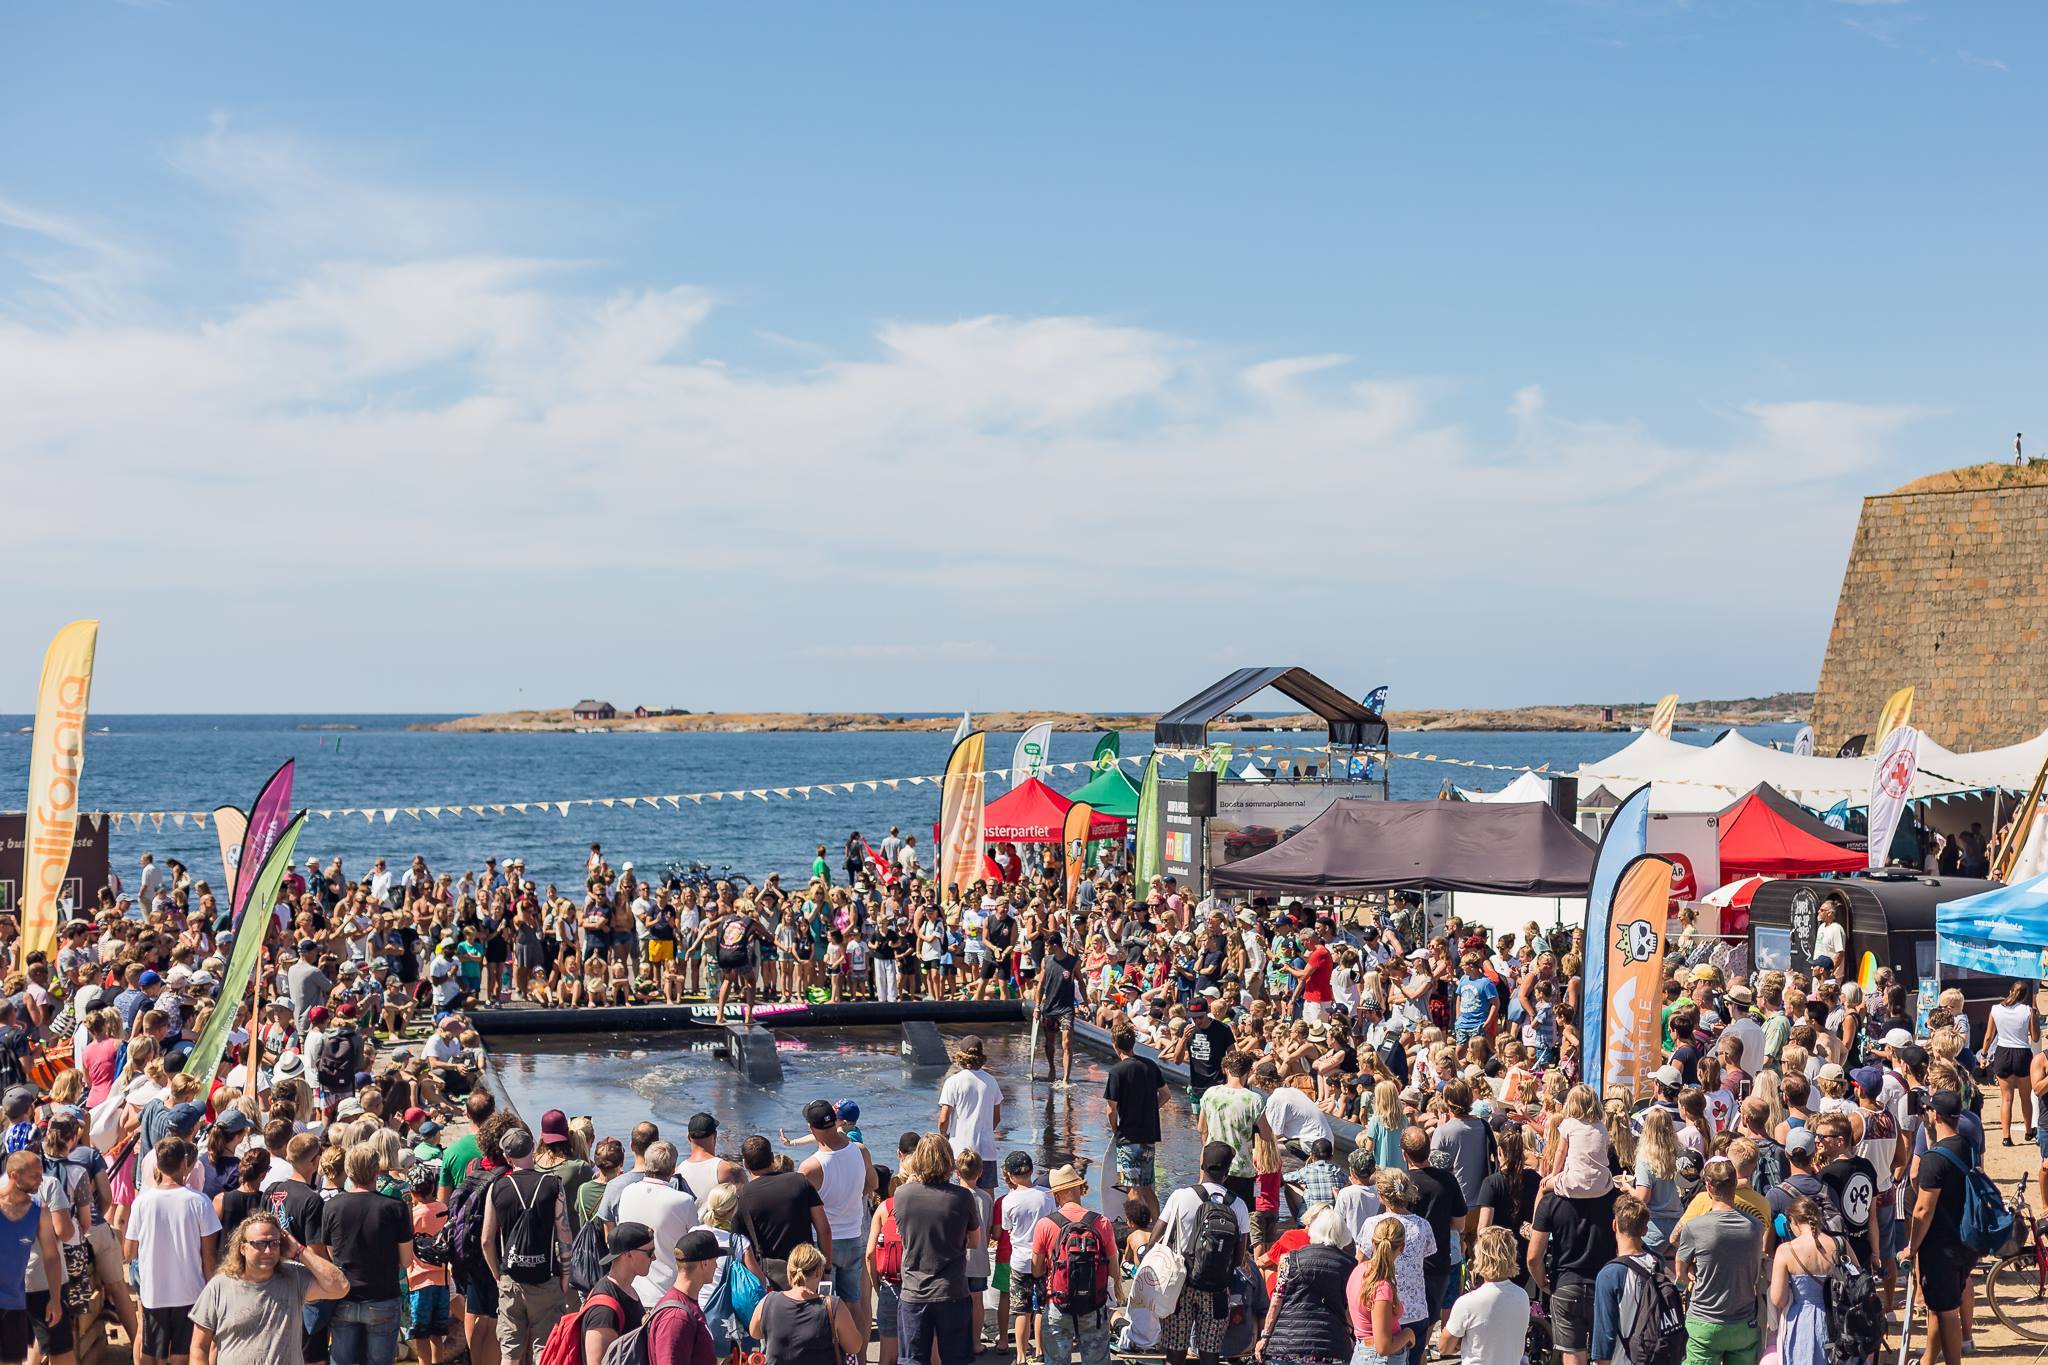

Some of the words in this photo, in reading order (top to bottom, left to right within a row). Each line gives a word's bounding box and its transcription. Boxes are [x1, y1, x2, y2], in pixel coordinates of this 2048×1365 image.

[29, 675, 88, 928] hallifornia
[1245, 801, 1306, 809] sommarplanerna!
[691, 1005, 742, 1017] URBAN
[744, 1004, 773, 1015] KIM
[1638, 999, 1652, 1094] MBATTLE
